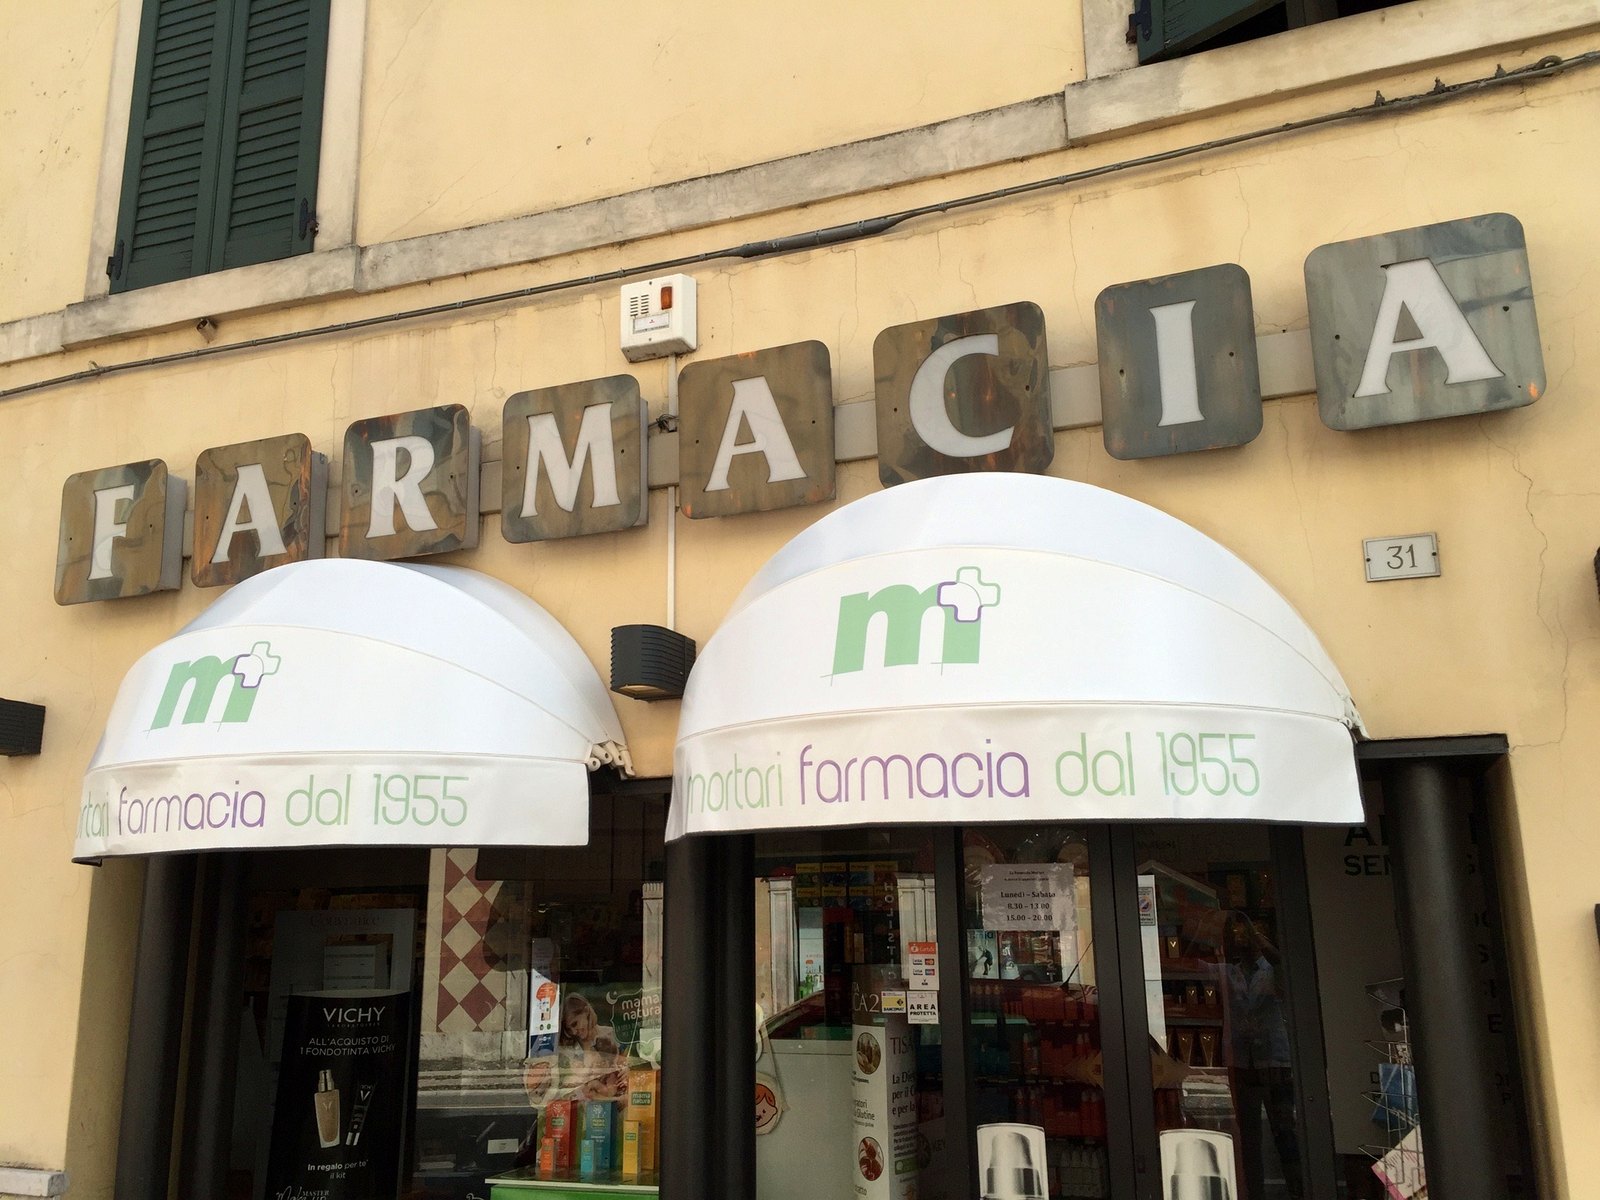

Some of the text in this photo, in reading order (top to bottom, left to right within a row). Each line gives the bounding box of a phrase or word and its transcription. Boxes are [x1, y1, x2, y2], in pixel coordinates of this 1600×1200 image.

[87, 256, 1507, 582] FARMACIA
[1386, 544, 1418, 570] 31
[799, 738, 1031, 806] farmacia
[1055, 731, 1136, 797] dal
[1155, 731, 1261, 797] 1955
[76, 773, 470, 839] rtari farmacia dal 1955
[1031, 890, 1056, 898] Sabato
[621, 994, 660, 1011] mama
[323, 1006, 386, 1023] VICHY
[623, 1005, 661, 1021] natura
[308, 1035, 390, 1046] ALL'ACQUISTO DI
[305, 1047, 370, 1056] FONDOTINTA
[372, 1043, 396, 1054] VICHY
[307, 1163, 316, 1171] In
[317, 1162, 343, 1172] regalo
